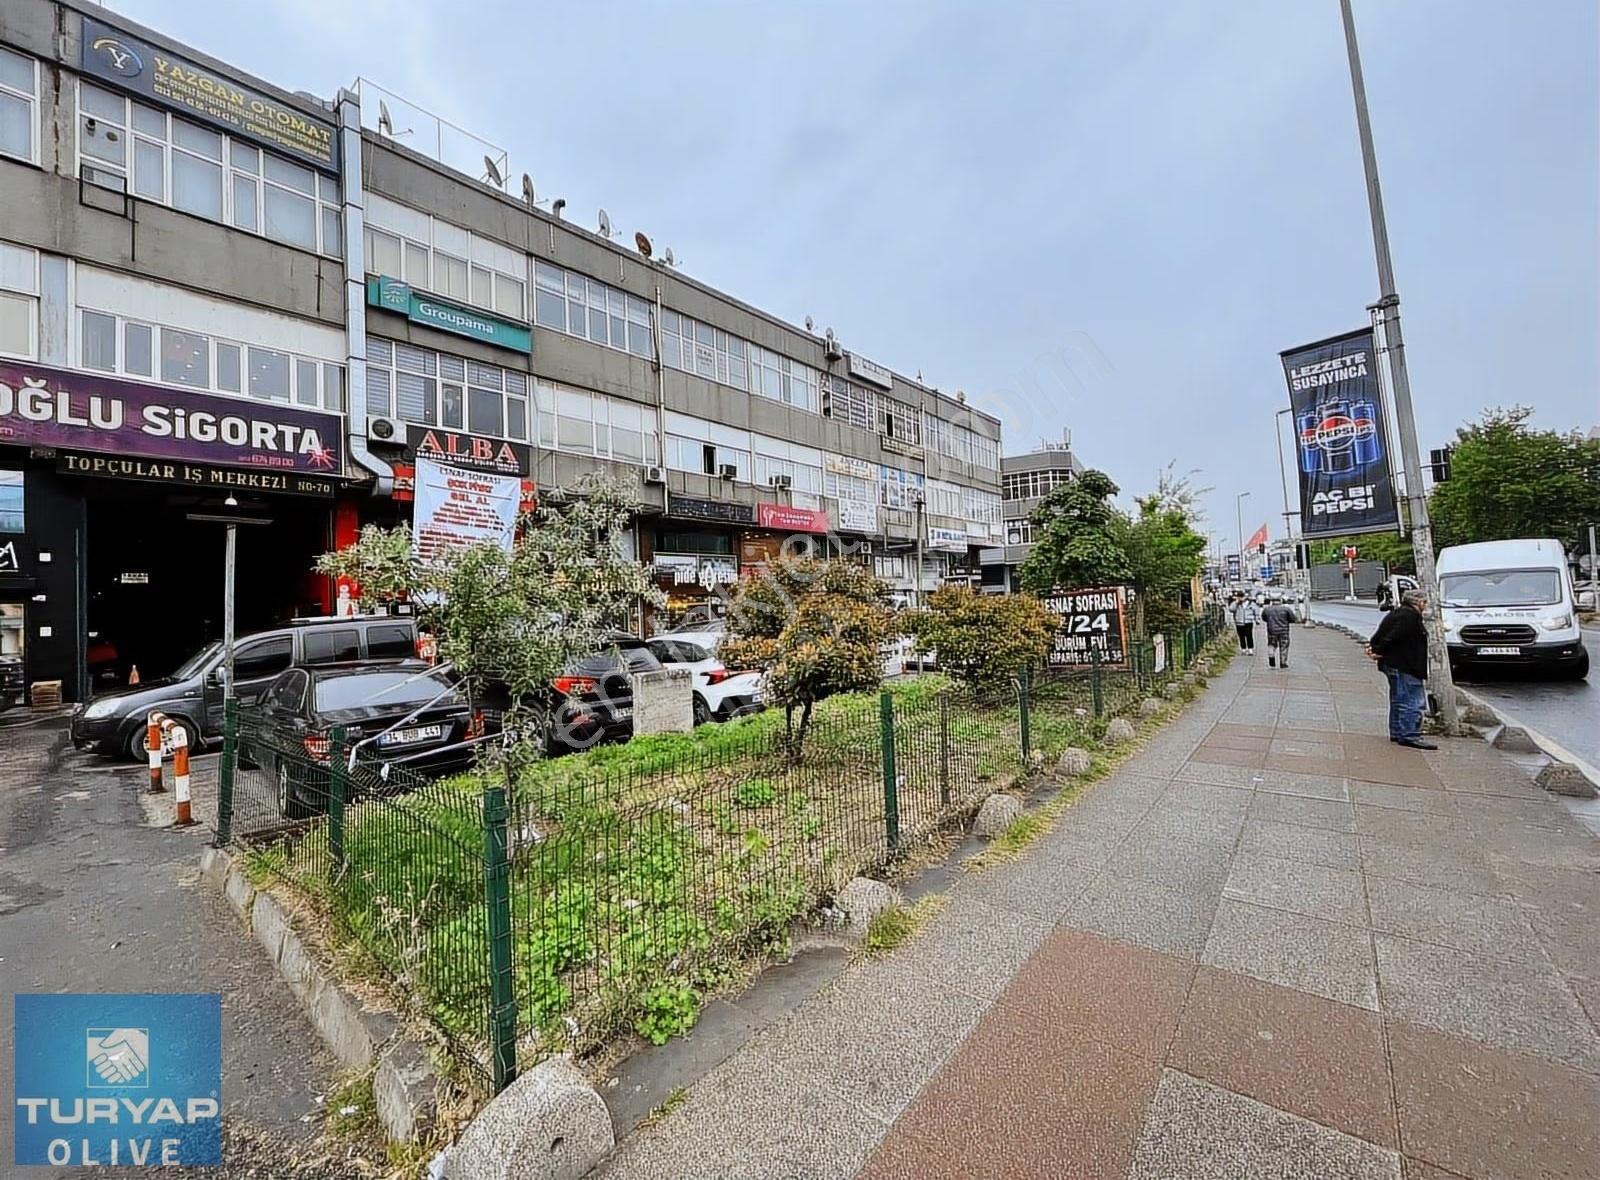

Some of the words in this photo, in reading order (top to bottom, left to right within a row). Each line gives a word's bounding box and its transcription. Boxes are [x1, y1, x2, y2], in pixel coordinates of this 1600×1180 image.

[154, 56, 244, 106] YAZGAN
[251, 100, 331, 142] OTOMAT
[419, 303, 494, 335] Groupama
[1291, 352, 1366, 379] LEZZETE
[1292, 364, 1367, 391] SUSAYINCA
[1317, 426, 1355, 439] PEPSI
[416, 430, 519, 464] ALBA
[65, 455, 176, 478] TOPÇULAR
[184, 466, 203, 483] İŞ
[1312, 497, 1375, 516] PEPSI
[1076, 592, 1117, 612] SOFRASI
